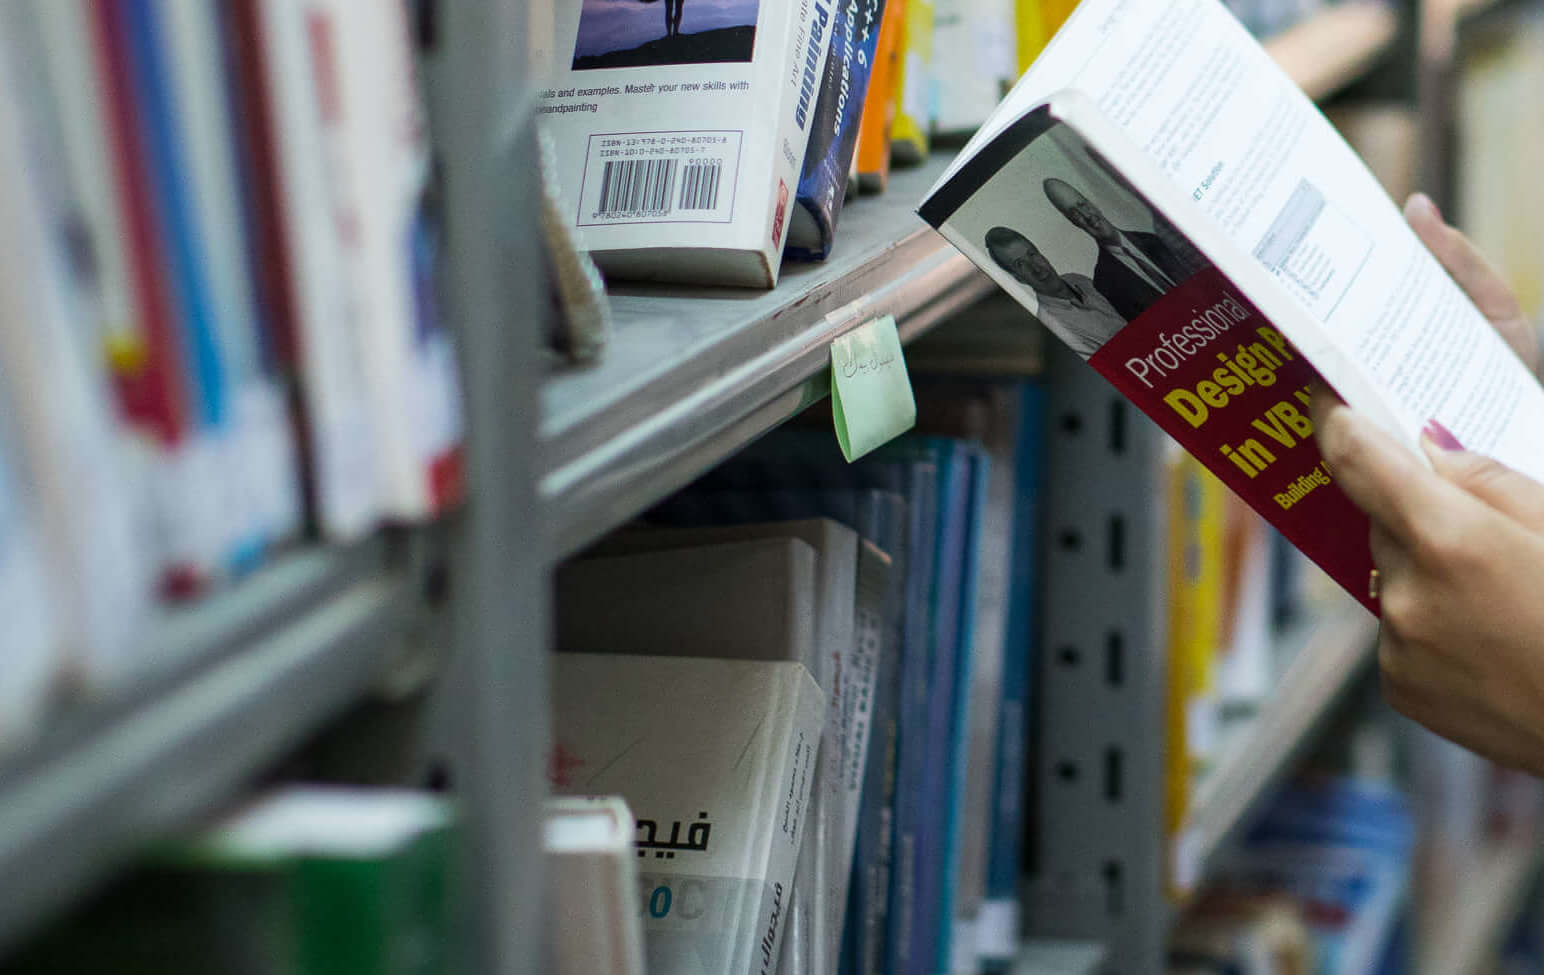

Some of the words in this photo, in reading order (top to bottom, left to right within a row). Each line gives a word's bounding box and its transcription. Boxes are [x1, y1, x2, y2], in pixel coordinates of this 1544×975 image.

[557, 87, 575, 98] and
[577, 85, 621, 98] examples.
[657, 82, 678, 94] your
[680, 82, 701, 93] new
[703, 81, 727, 92] skills
[729, 80, 750, 91] with
[795, 1, 829, 131] Painting
[857, 48, 868, 69] 6
[1124, 290, 1248, 389] Professional
[1163, 337, 1285, 429] Design
[1219, 435, 1278, 479] in
[1251, 400, 1314, 450] VB
[1272, 466, 1331, 511] Building
